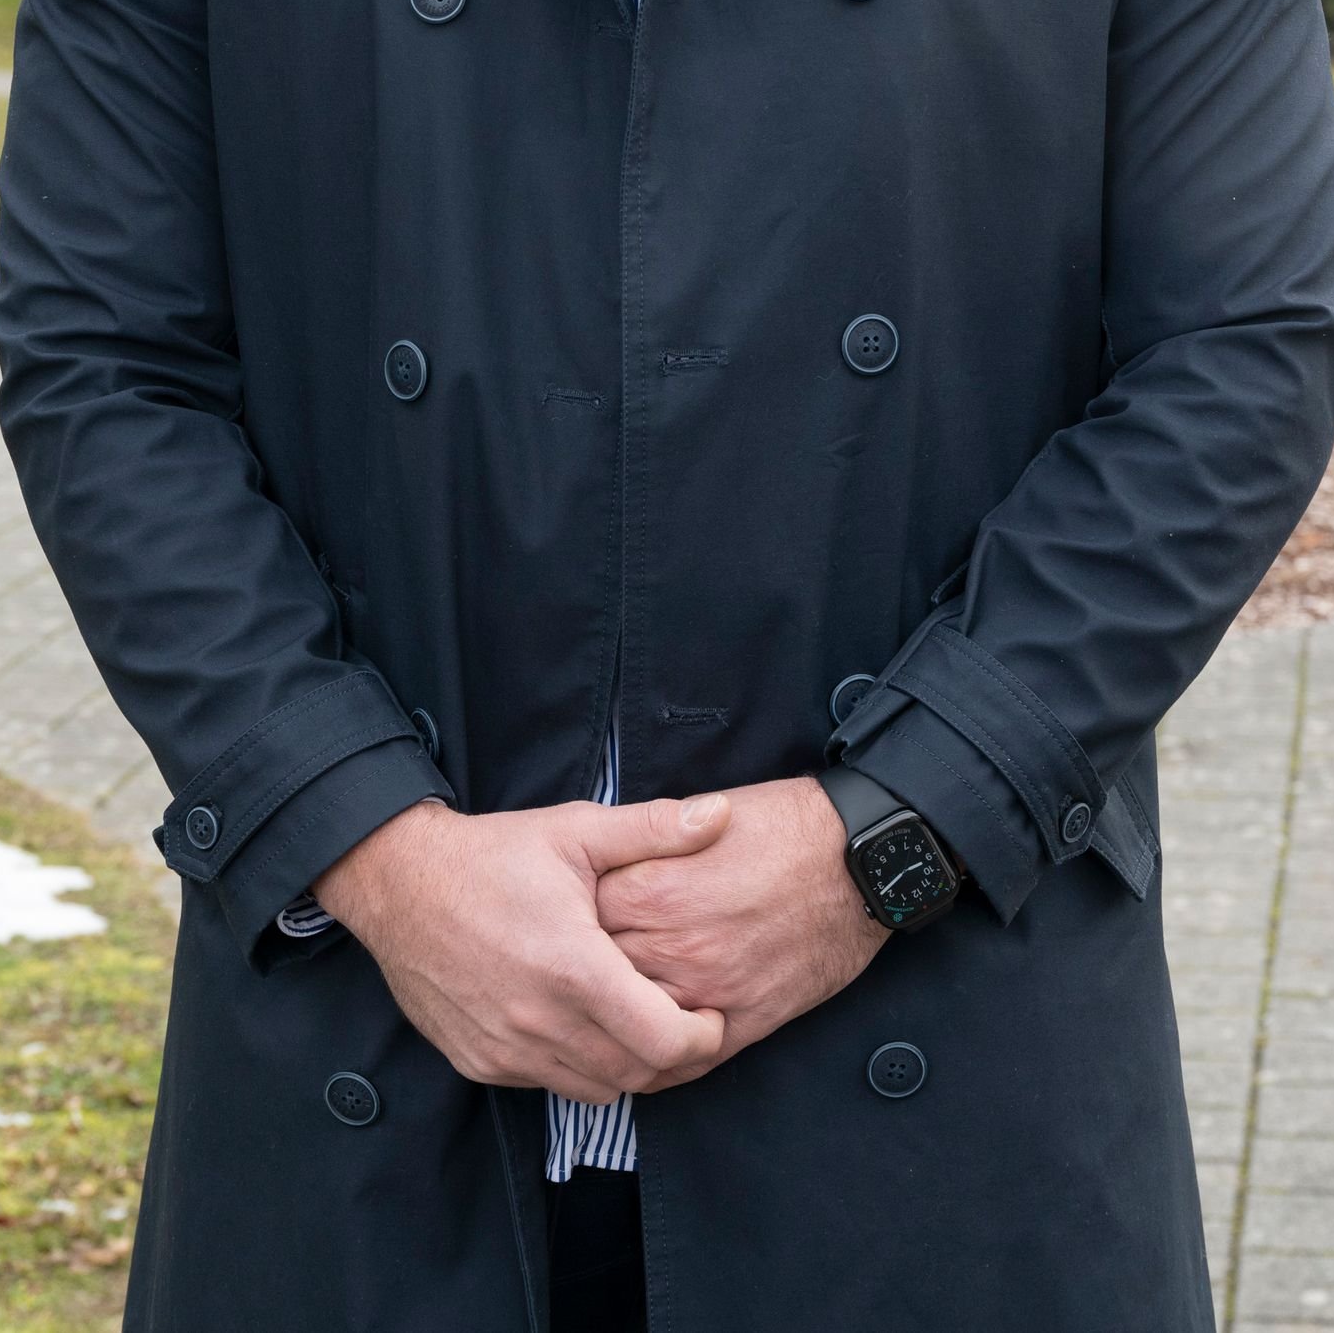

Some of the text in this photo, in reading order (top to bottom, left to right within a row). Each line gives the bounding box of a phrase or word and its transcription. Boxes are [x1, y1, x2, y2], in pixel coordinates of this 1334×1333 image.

[889, 845, 895, 853] 6
[904, 842, 909, 850] 7
[880, 856, 886, 864] 5
[875, 868, 881, 876] 4
[924, 866, 934, 875] 10
[921, 879, 930, 887] 11
[887, 888, 894, 897] 2
[911, 888, 922, 898] 12
